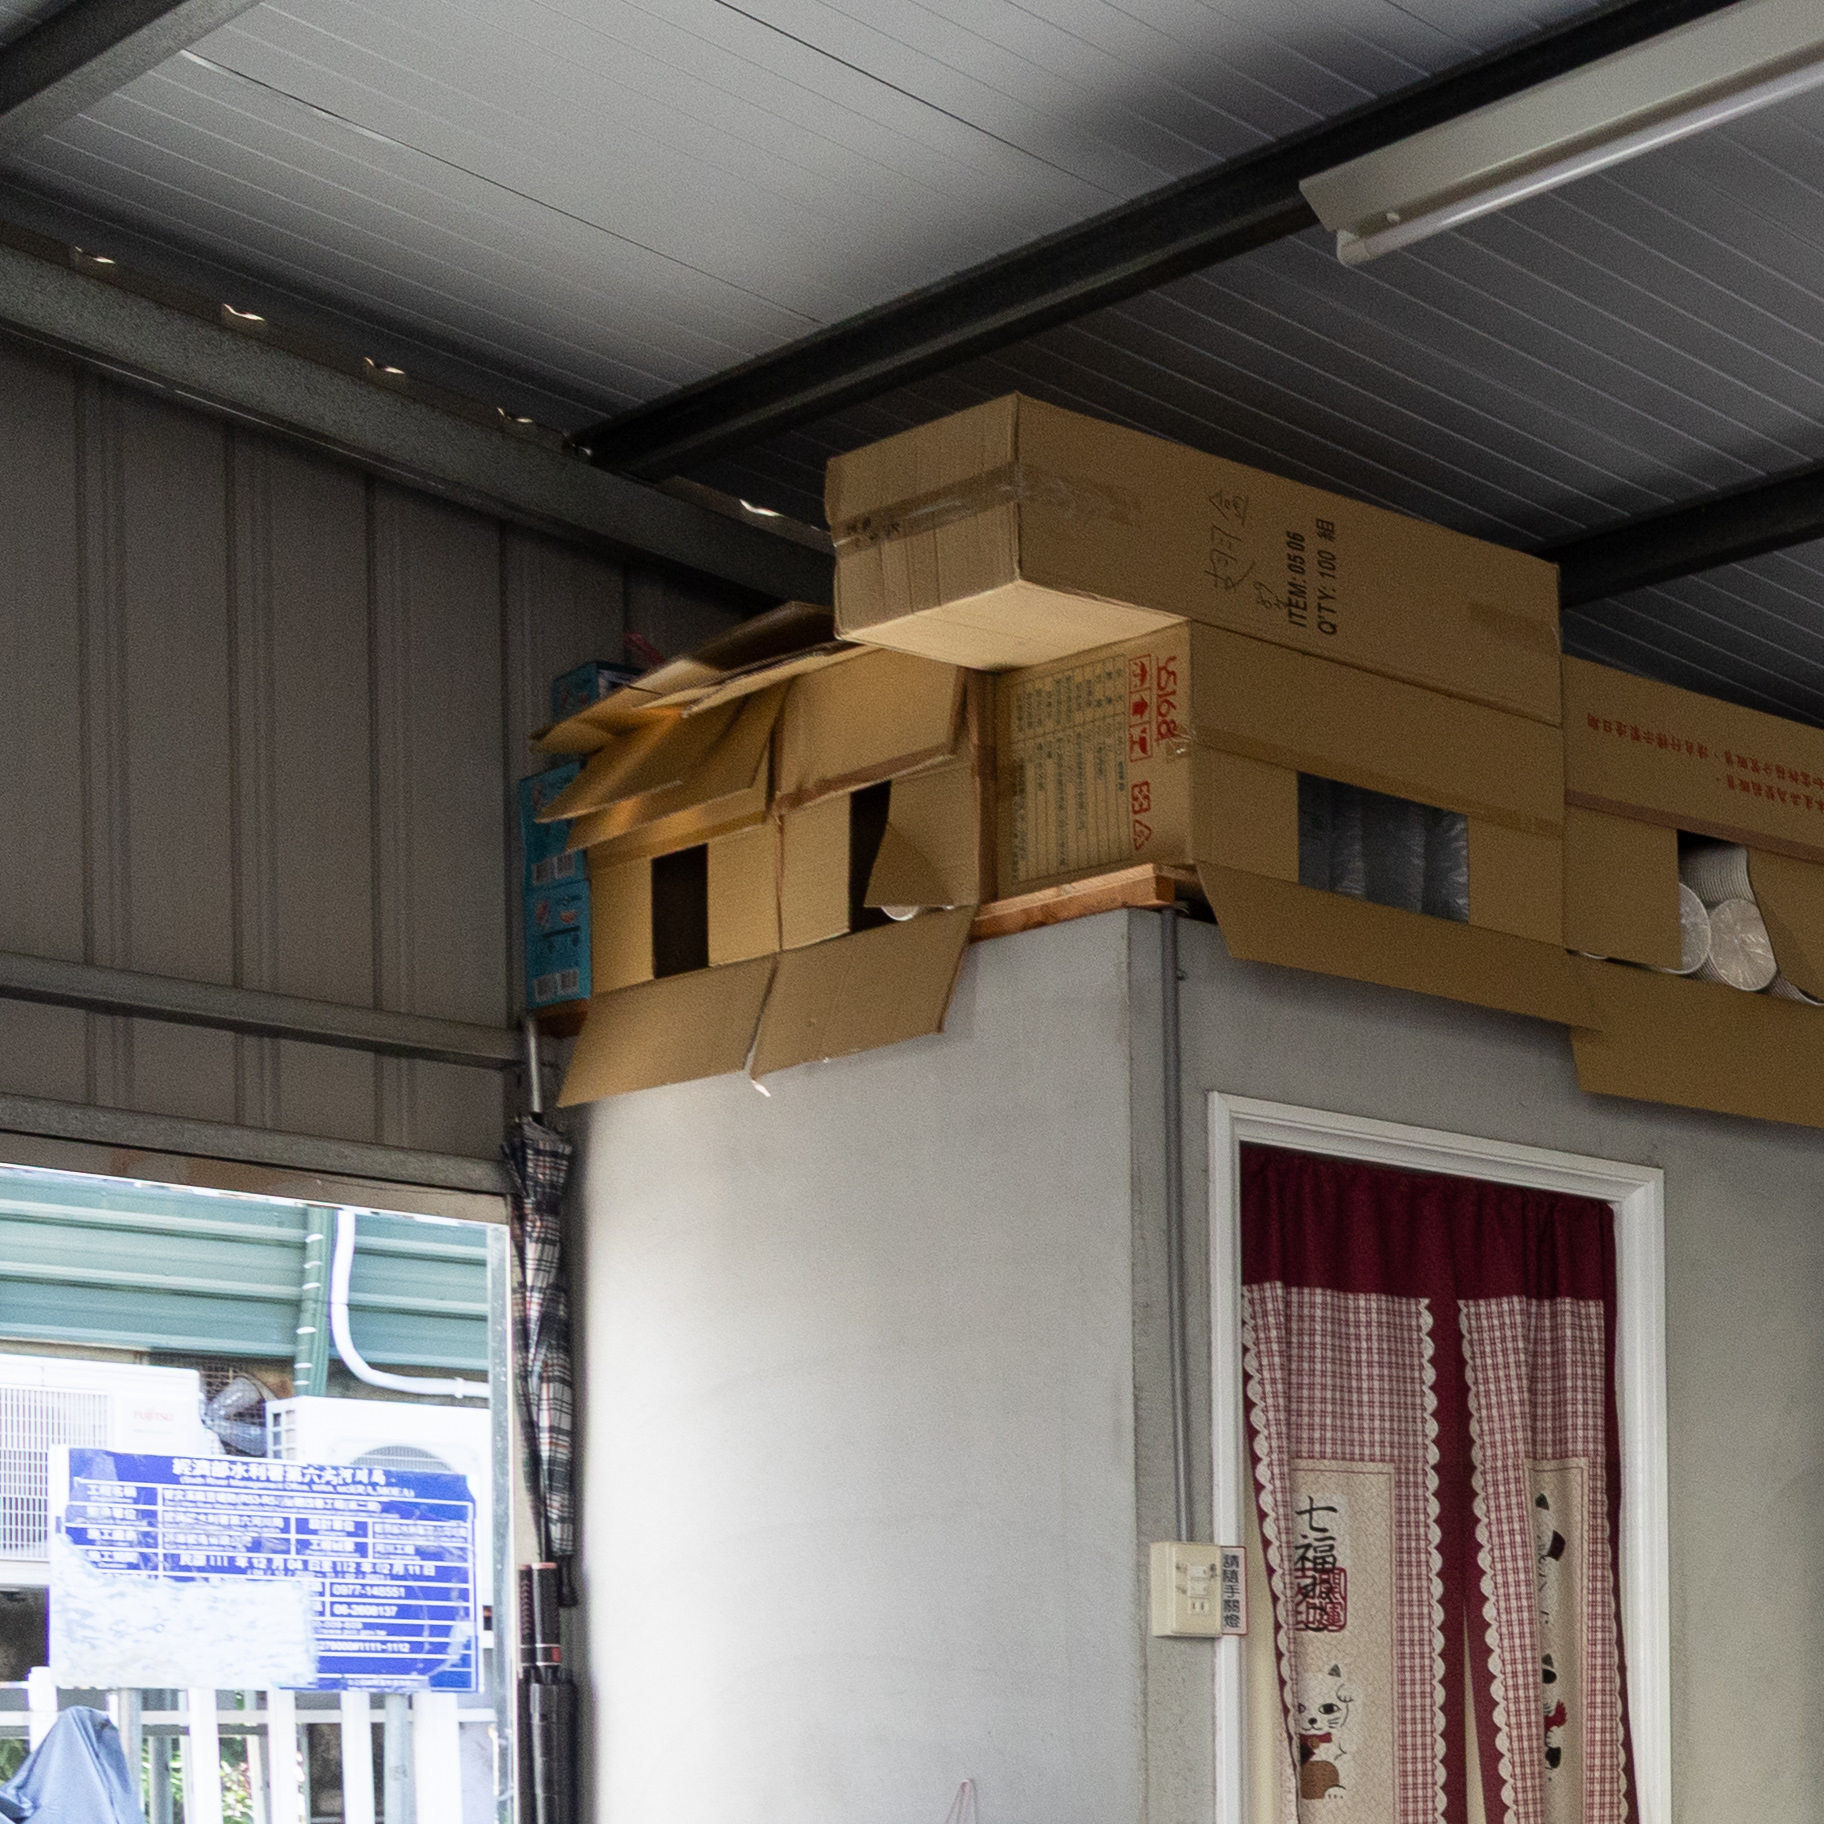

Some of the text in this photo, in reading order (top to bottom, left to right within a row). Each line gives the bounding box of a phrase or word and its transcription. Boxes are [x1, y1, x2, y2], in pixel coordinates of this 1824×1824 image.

[1315, 518, 1336, 543] 組
[1318, 550, 1337, 579] 100
[1222, 1554, 1240, 1628] 請隨手關燈
